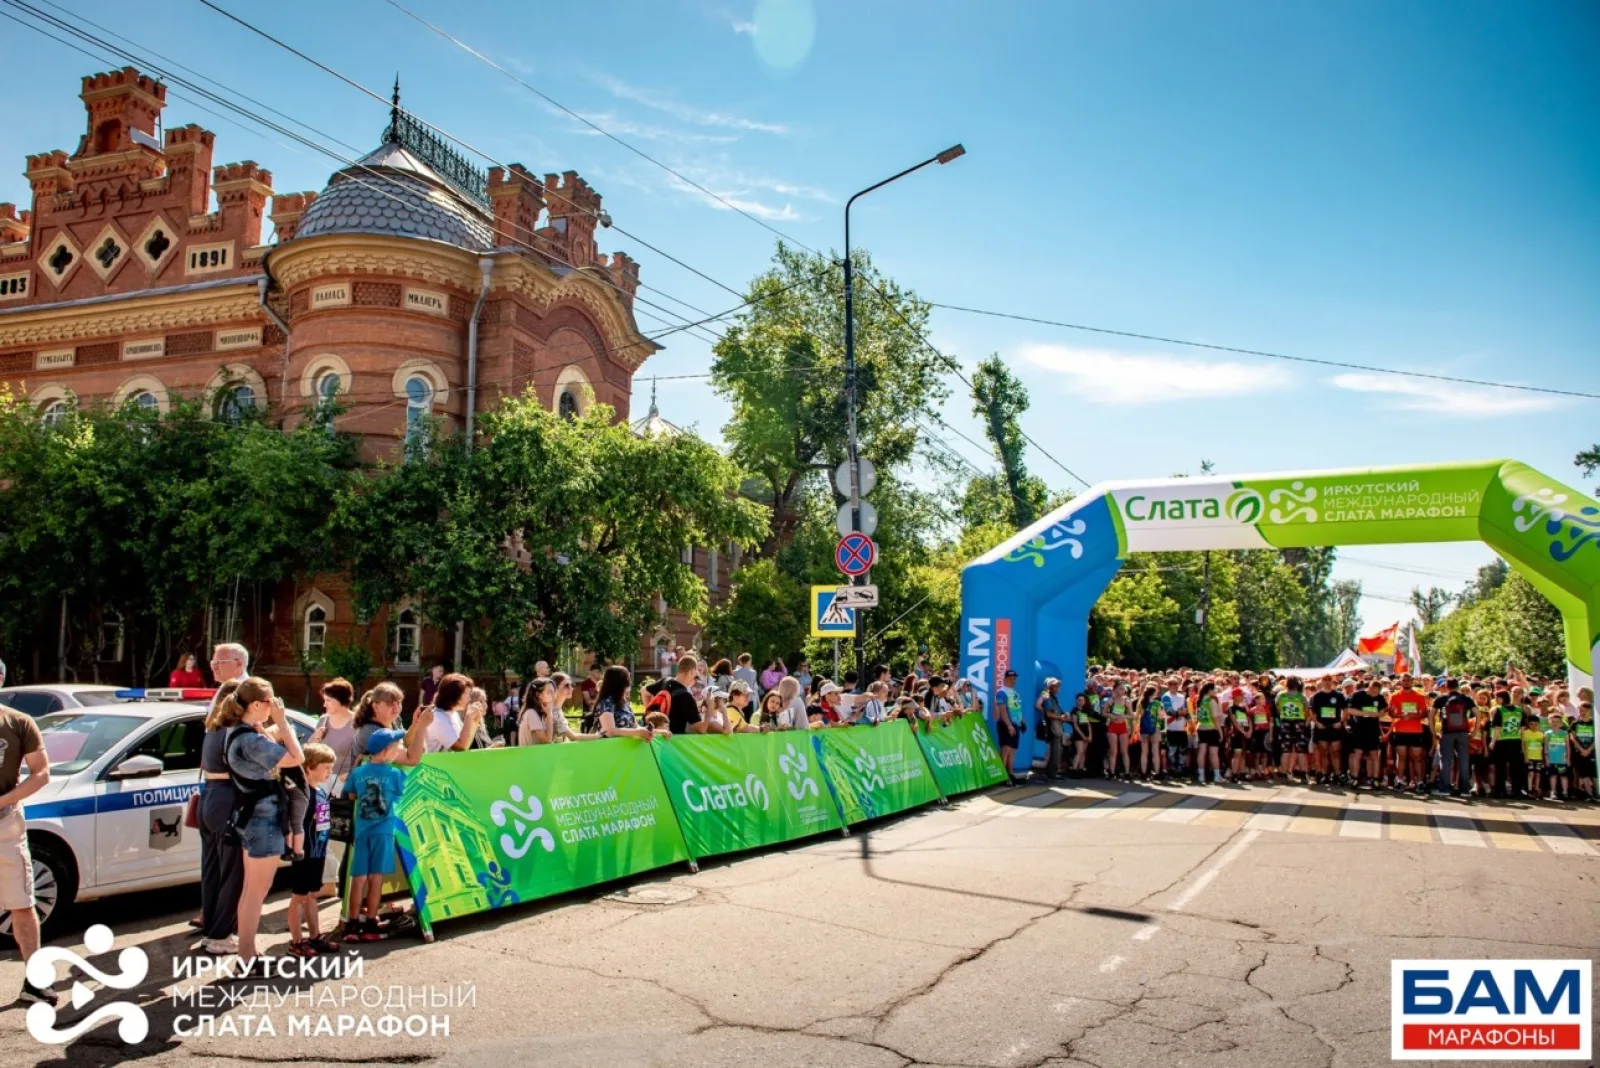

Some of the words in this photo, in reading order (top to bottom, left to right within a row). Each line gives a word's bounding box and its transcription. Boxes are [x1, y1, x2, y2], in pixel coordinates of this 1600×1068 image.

[191, 249, 226, 269] 1891
[1323, 480, 1420, 496] ИРКУТСКИЙ
[1323, 489, 1479, 509] МЕЖДУНАРОДНЫЙ
[1125, 496, 1219, 521] Слата
[1324, 509, 1375, 522] СЛАТА
[1381, 505, 1466, 520] МАРАФОН
[133, 785, 201, 806] ПОЛИЦИЯ
[550, 786, 618, 811] ИРКУТСКИЙ
[682, 779, 748, 812] Слата
[556, 795, 659, 827] МЕЖДУНАРОДНЫЙ
[562, 825, 600, 843] СЛАТА
[601, 814, 656, 836] МАРАФОН
